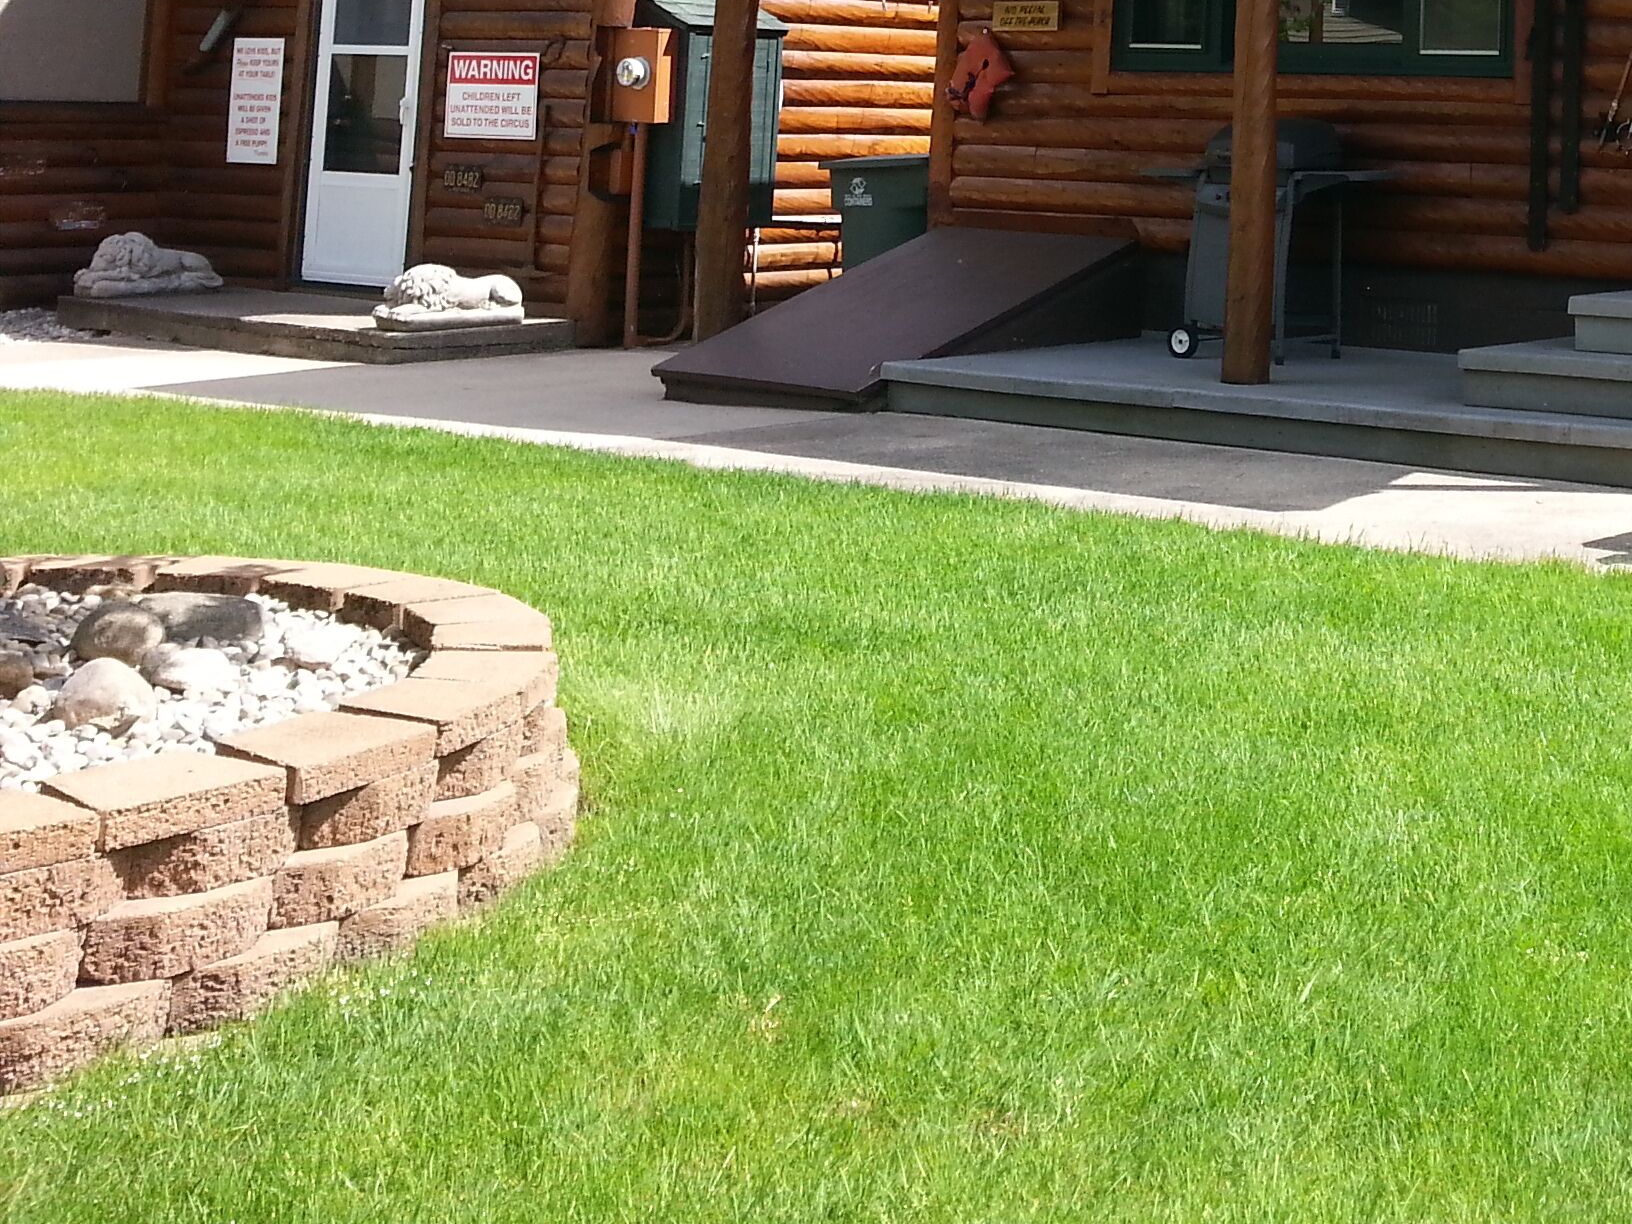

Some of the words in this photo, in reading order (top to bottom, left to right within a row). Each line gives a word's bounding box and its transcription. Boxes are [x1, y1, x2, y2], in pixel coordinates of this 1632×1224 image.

[453, 59, 534, 81] WARNING
[462, 92, 500, 102] CHILDREN
[502, 92, 521, 102] LEFT
[449, 104, 500, 114] UNATTENDED
[501, 105, 519, 115] WILL
[521, 106, 533, 116] BE
[451, 117, 472, 127] SOLD
[473, 118, 483, 127] TO
[484, 118, 499, 128] THE
[500, 119, 530, 129] CIRCUS
